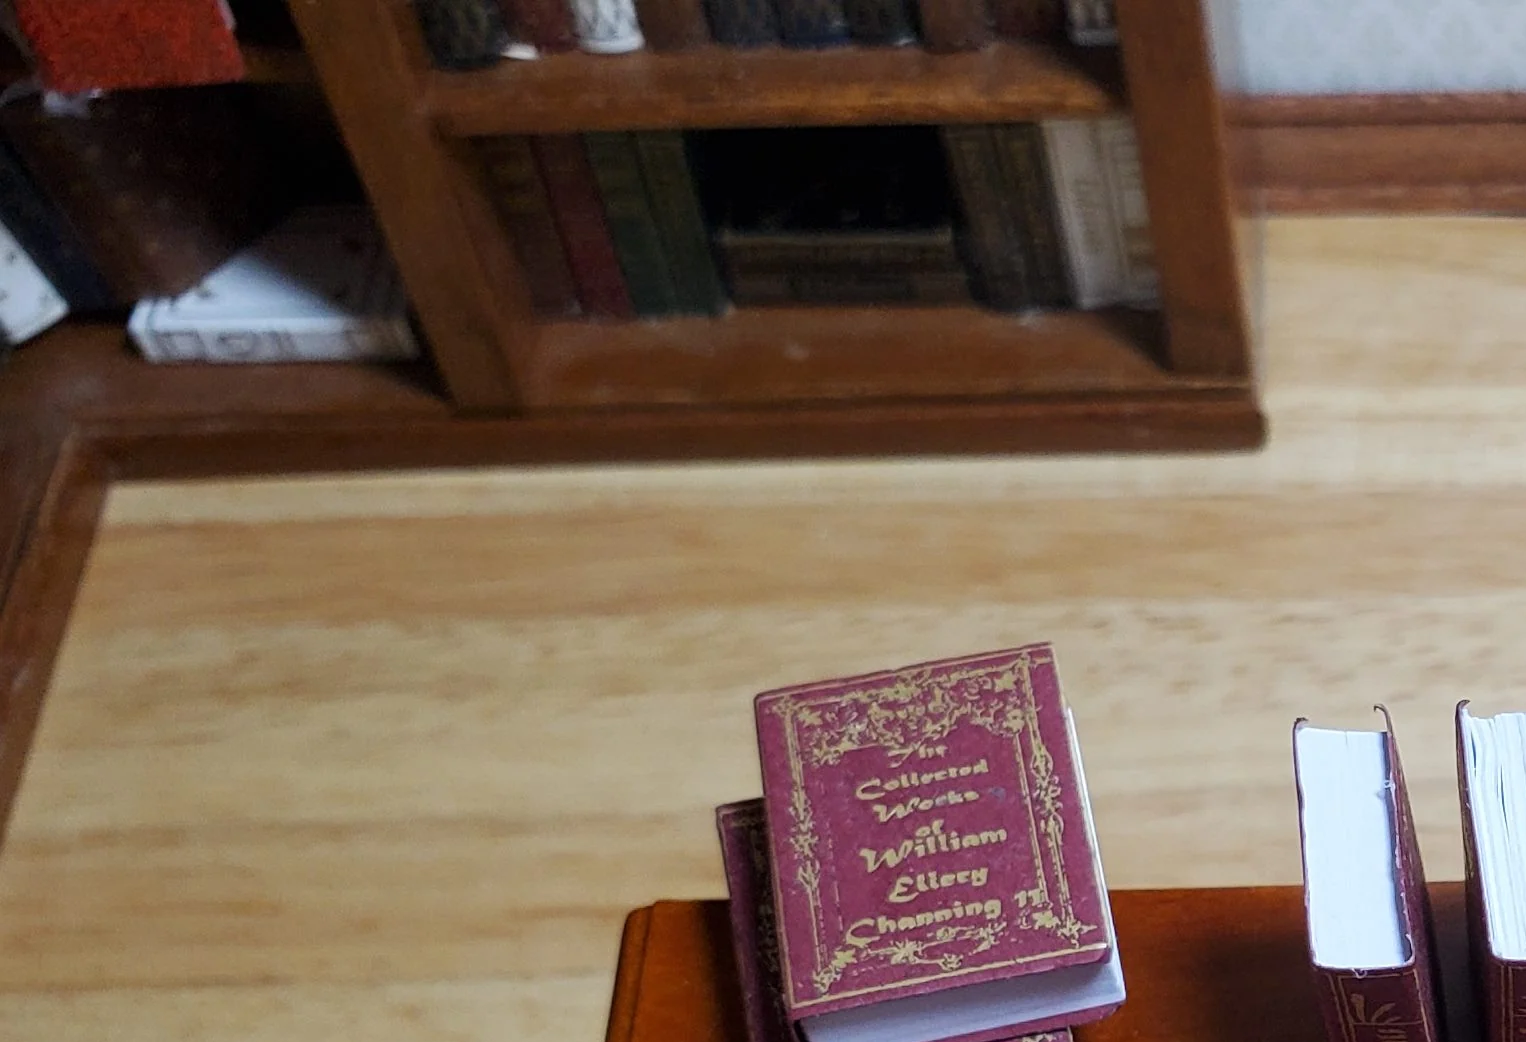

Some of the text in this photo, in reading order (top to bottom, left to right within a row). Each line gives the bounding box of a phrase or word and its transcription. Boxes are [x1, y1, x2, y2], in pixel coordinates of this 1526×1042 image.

[888, 741, 948, 768] The
[856, 759, 988, 800] Collected
[873, 791, 979, 822] Works
[915, 820, 944, 837] of
[860, 829, 1007, 873] William
[888, 868, 988, 902] Ellery
[846, 900, 1002, 946] Channing
